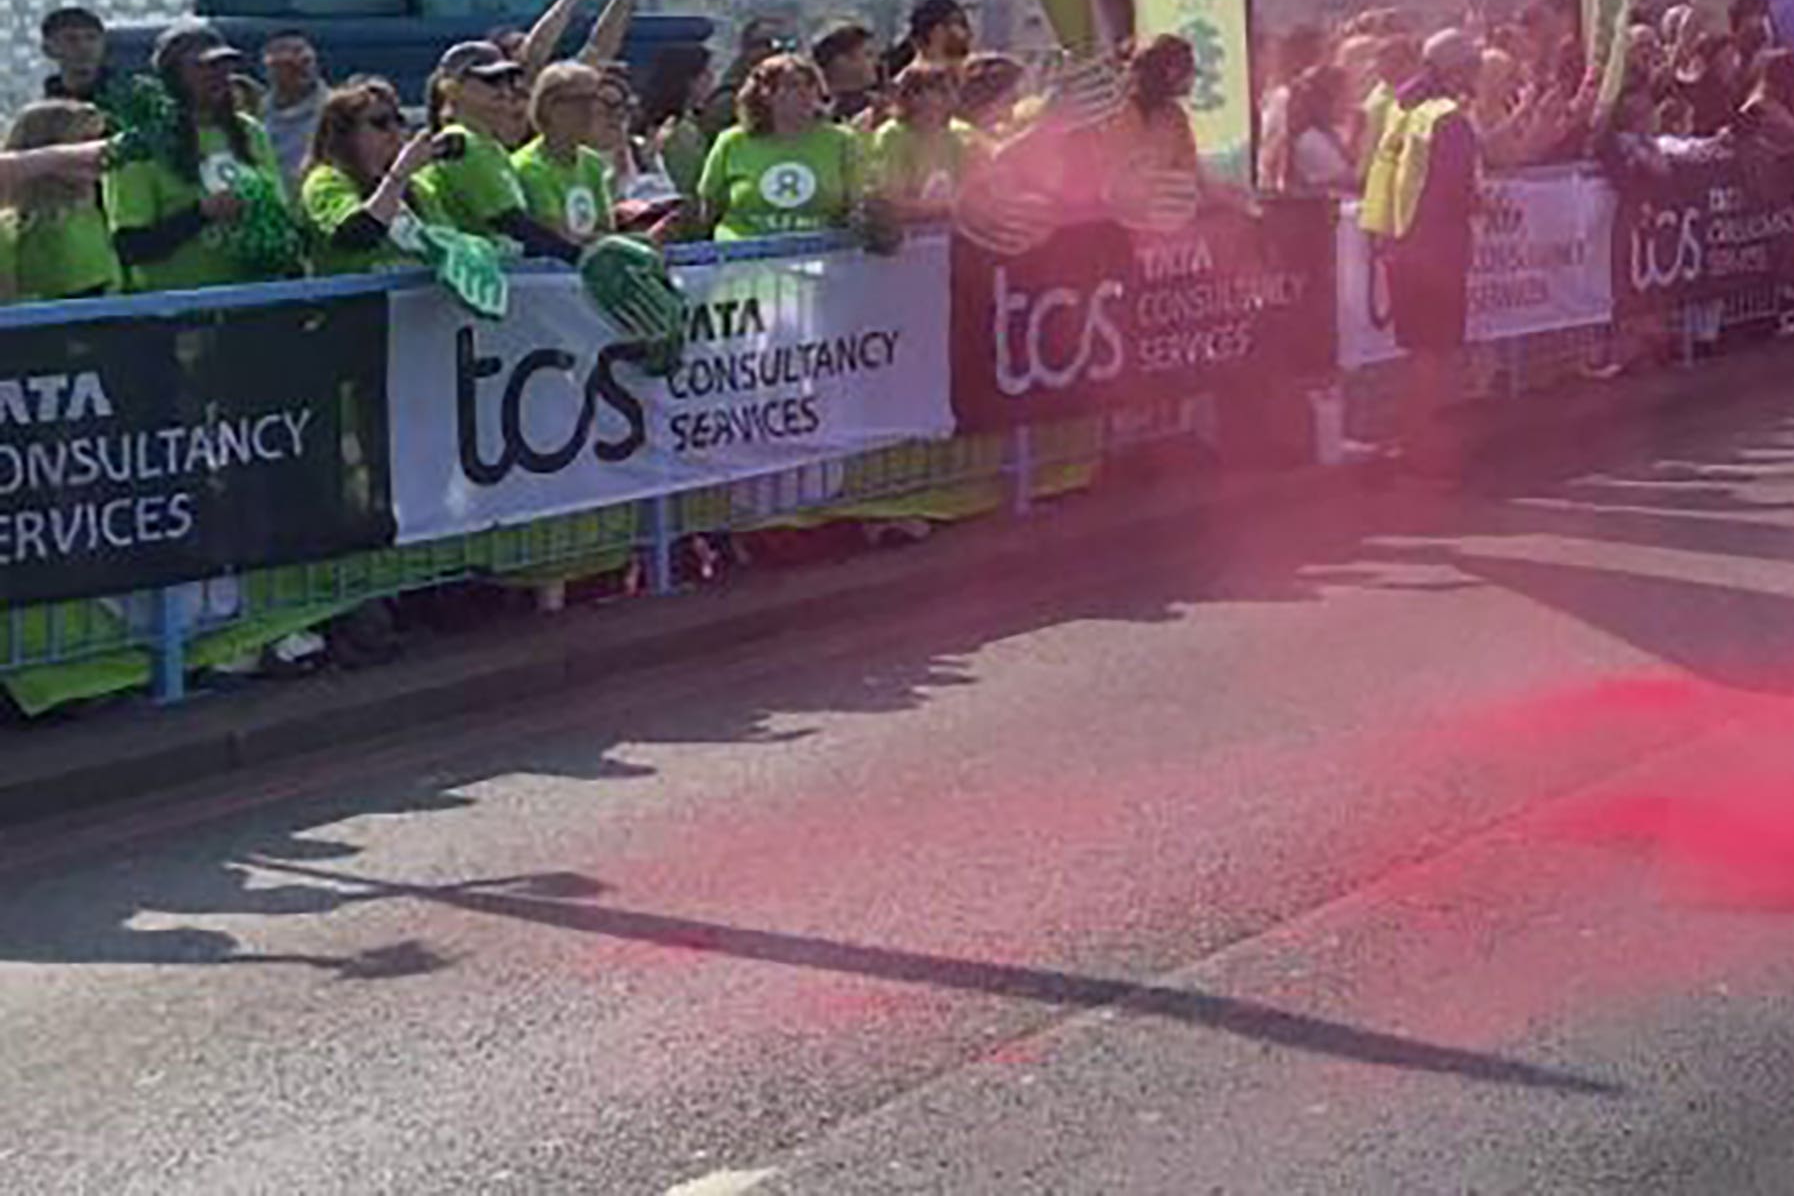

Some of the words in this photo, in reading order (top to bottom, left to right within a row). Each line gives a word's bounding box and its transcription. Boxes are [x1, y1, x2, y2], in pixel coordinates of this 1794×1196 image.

[666, 330, 900, 400] CONSULTANCY
[995, 266, 1124, 395] tcs
[456, 325, 652, 486] tcs
[669, 397, 820, 453] SERVICES
